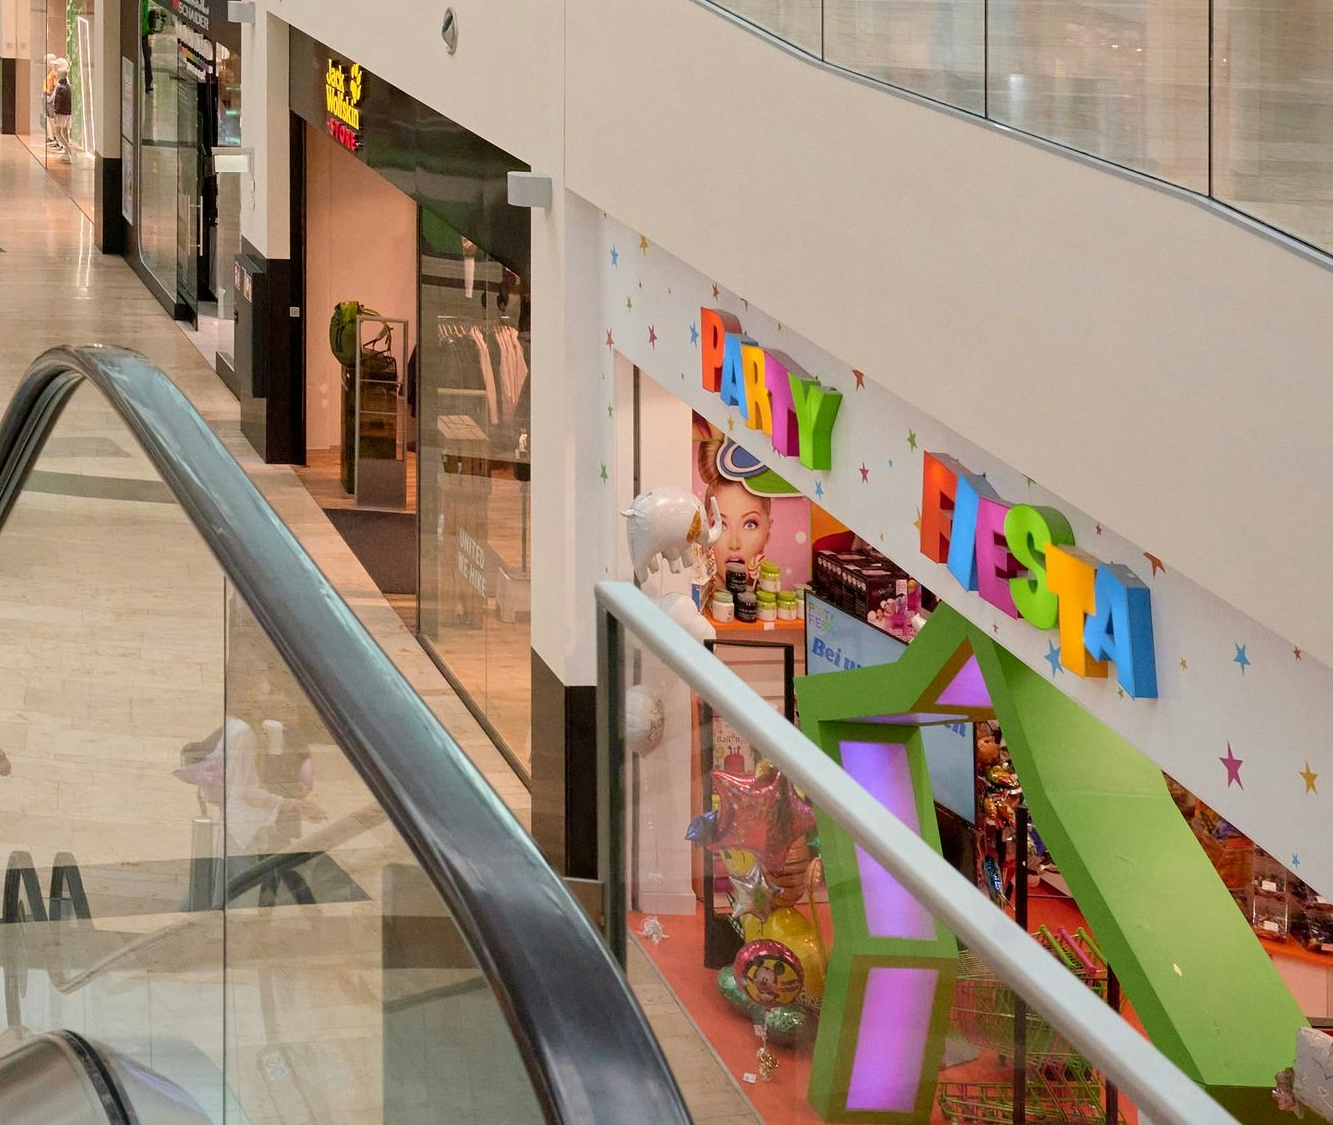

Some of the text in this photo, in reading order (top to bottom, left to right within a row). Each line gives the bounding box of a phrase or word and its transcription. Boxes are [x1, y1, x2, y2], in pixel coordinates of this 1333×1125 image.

[178, 0, 209, 31] SCHAIDER
[326, 58, 345, 94] Jack
[326, 84, 359, 130] Wolfskin
[700, 306, 843, 471] PARTY
[459, 526, 485, 570] UNITED
[920, 450, 1159, 699] FIESTA
[811, 636, 842, 669] Bei
